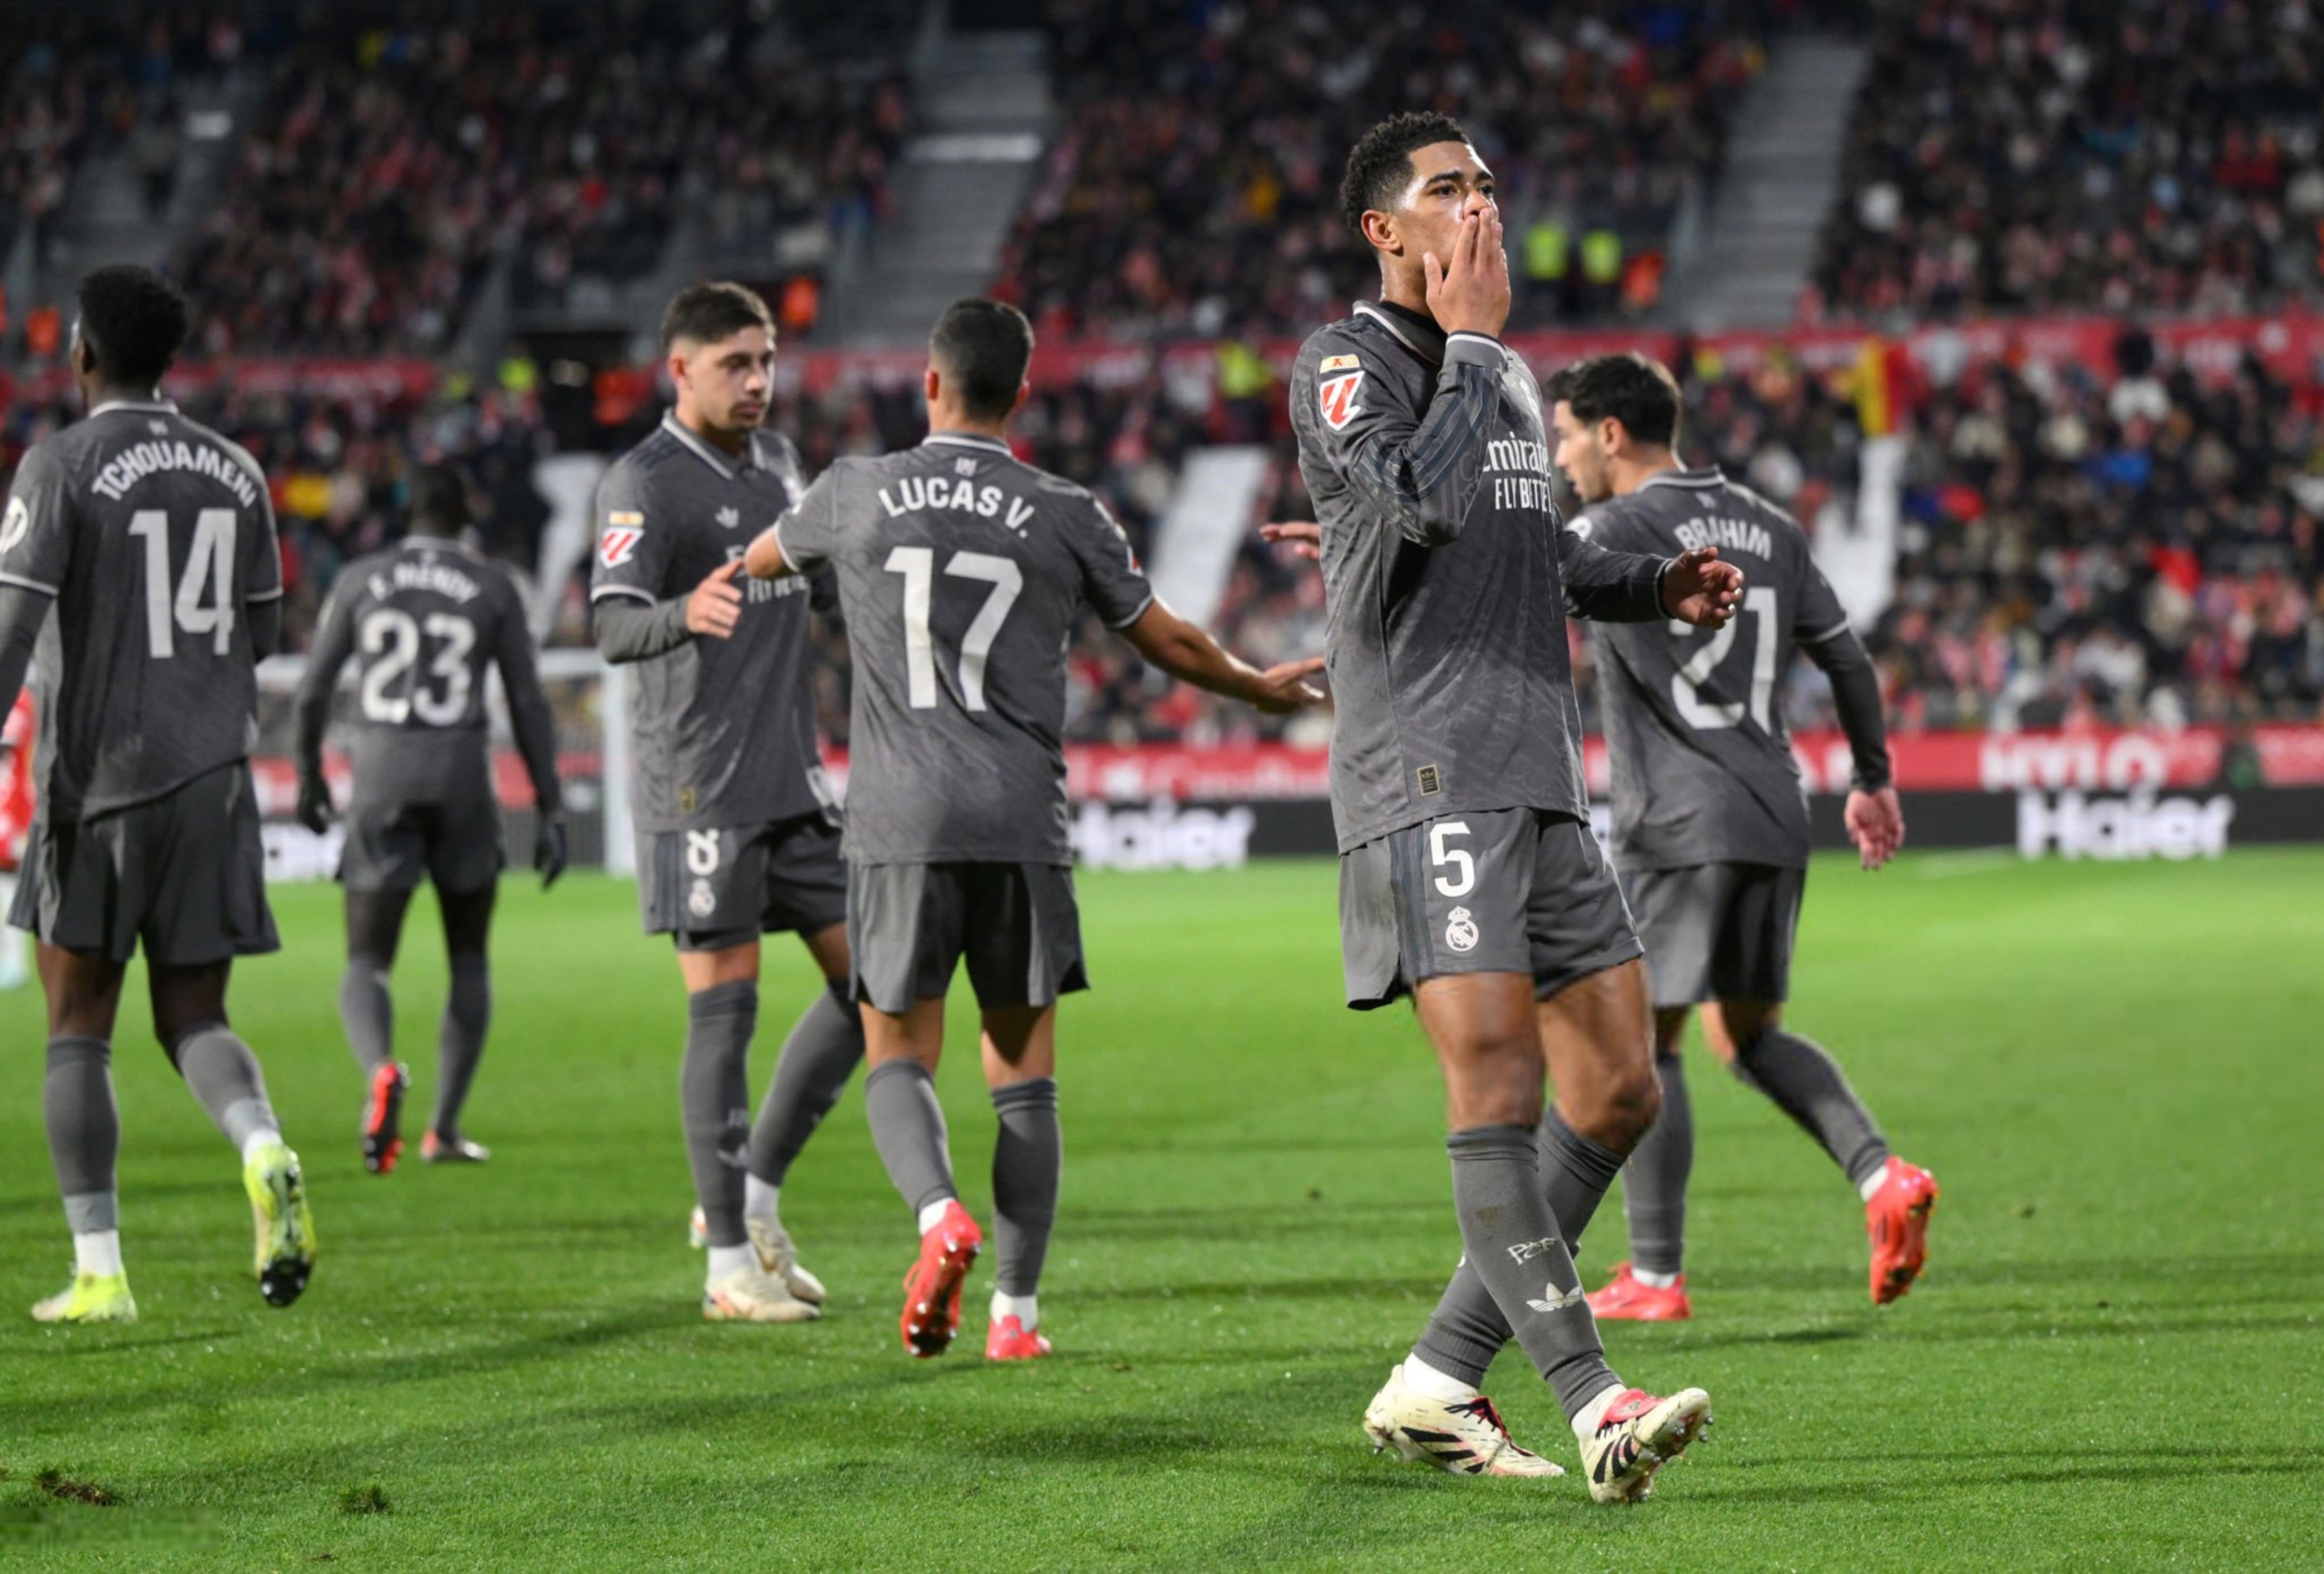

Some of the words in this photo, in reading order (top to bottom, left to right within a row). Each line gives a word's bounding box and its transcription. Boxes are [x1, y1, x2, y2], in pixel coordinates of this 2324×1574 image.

[1483, 431, 1551, 477] mirate
[878, 477, 1003, 517] LUCAS
[1004, 495, 1035, 538] V.
[1495, 477, 1517, 510] FLY
[1674, 515, 1772, 562] BRAHIM
[128, 508, 237, 658] 14
[884, 546, 1023, 712] 17
[1671, 586, 1778, 736] 21
[361, 608, 475, 727] 23
[686, 827, 720, 877] 8
[2016, 780, 2237, 861] Haier
[1430, 822, 1475, 897] 5
